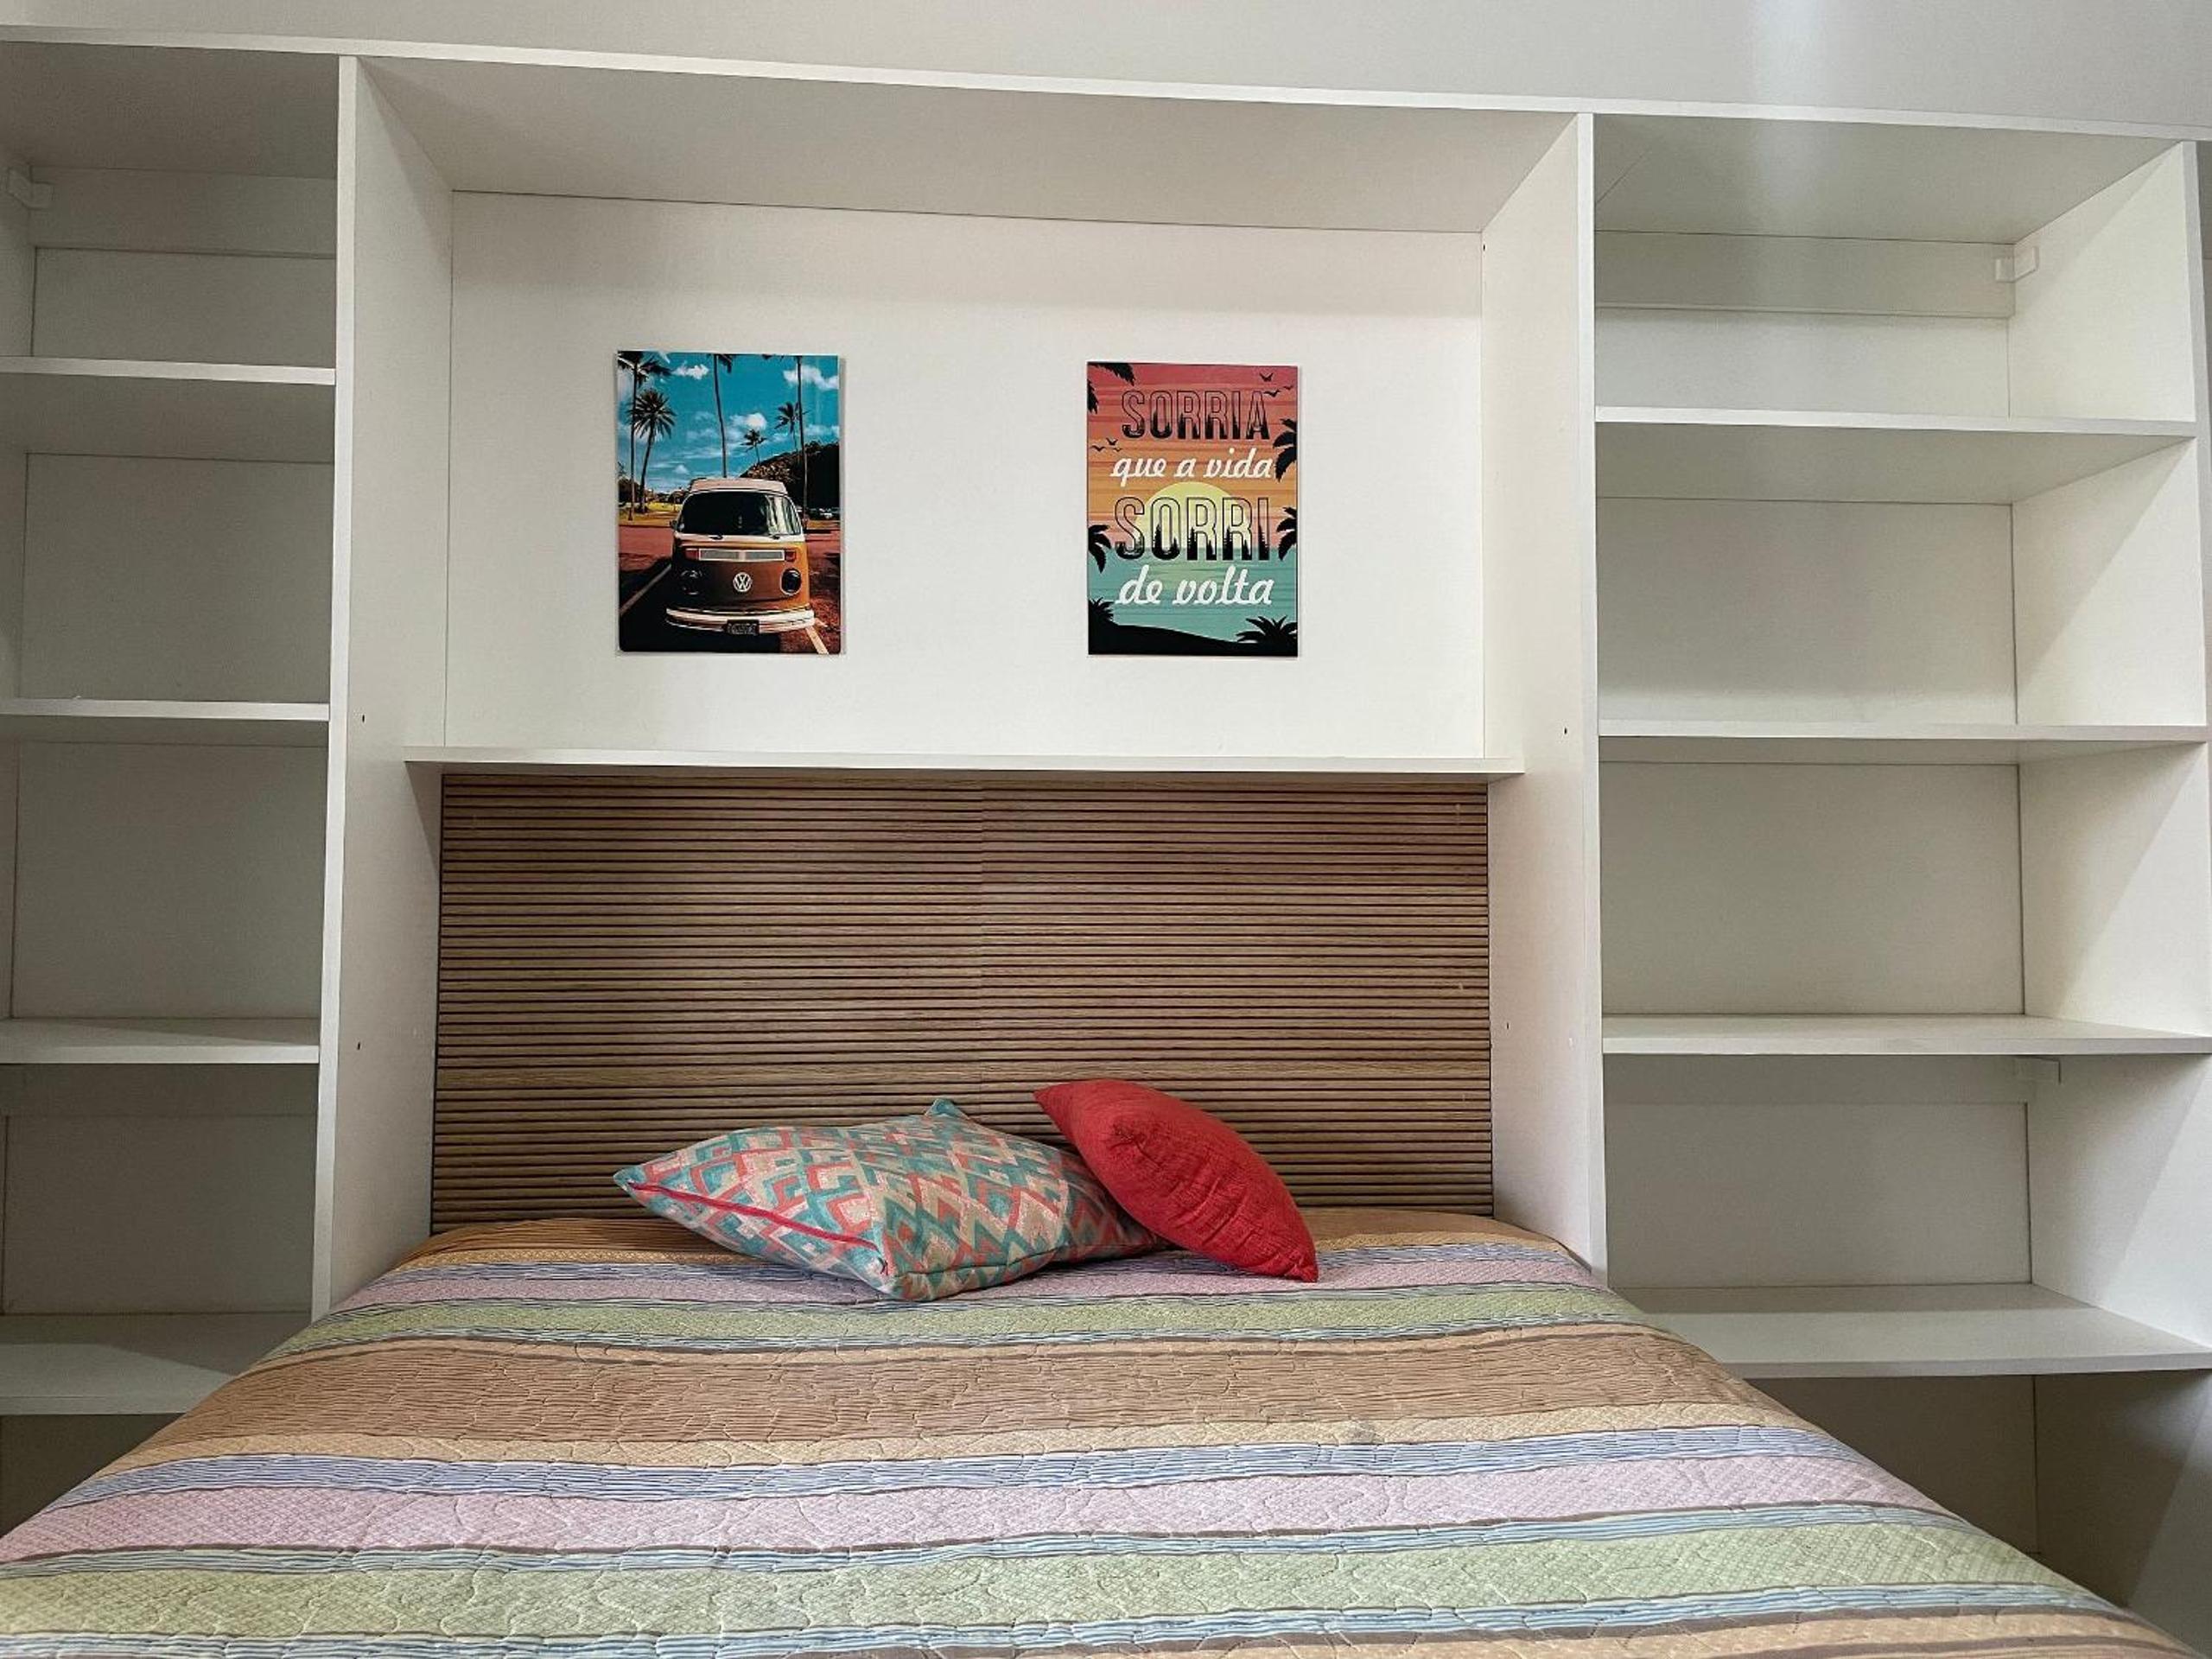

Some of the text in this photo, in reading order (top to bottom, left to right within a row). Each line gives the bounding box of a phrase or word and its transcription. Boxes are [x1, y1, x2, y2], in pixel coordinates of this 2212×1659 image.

[1122, 391, 1270, 440] SORRIA
[1109, 448, 1275, 487] que a vida
[1114, 497, 1270, 561] SORRI
[1115, 564, 1274, 606] de volta
